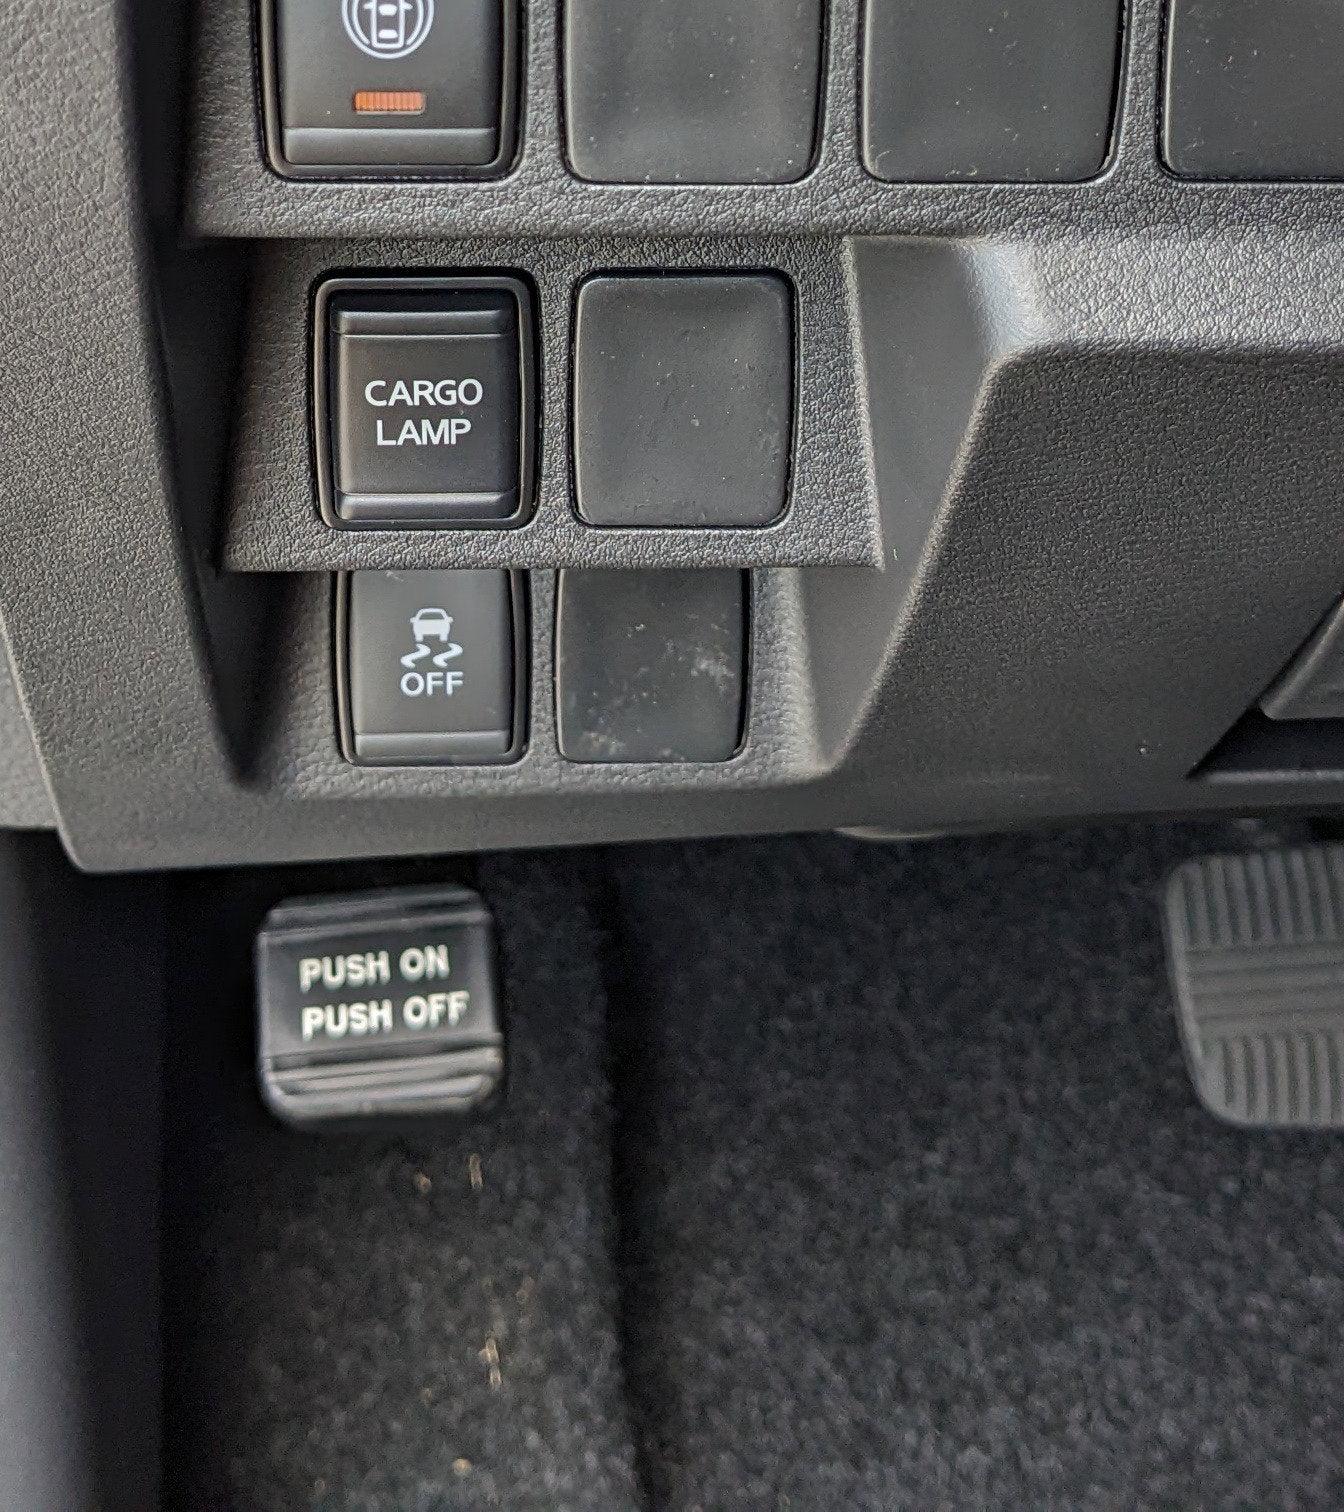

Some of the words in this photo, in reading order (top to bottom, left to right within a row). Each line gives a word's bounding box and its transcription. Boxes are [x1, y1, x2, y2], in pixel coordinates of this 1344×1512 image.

[364, 378, 483, 407] CARGO
[376, 419, 472, 447] LAMP
[399, 672, 464, 698] OFF
[298, 950, 391, 993] PUSH
[399, 944, 450, 981] ON
[301, 998, 393, 1042] PUSH
[403, 990, 470, 1030] OFF
